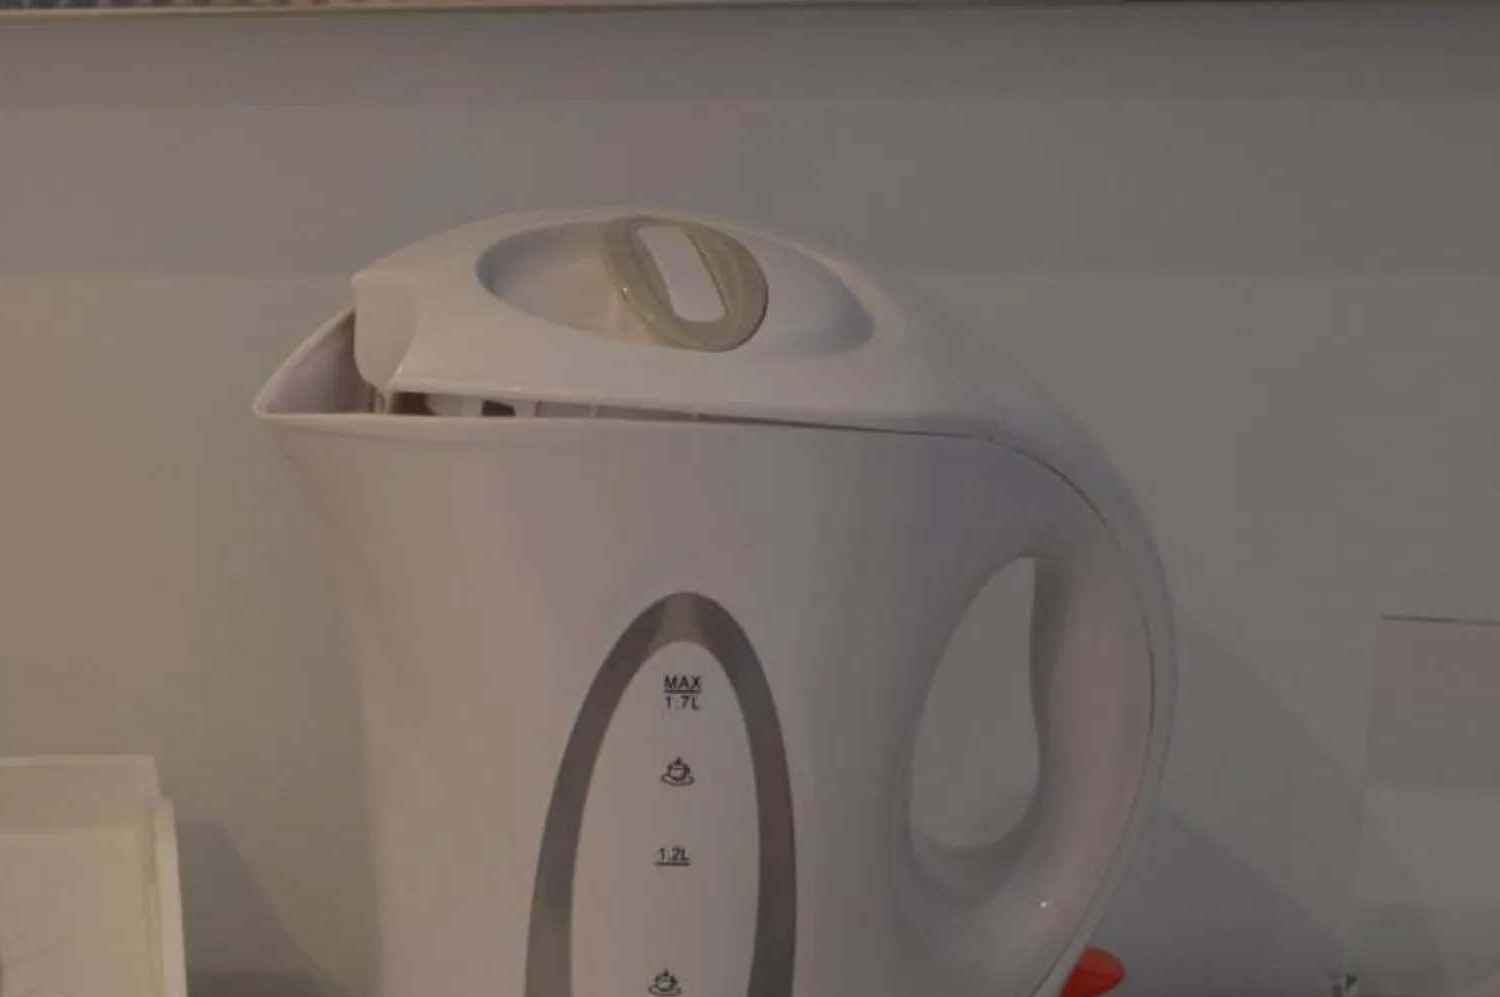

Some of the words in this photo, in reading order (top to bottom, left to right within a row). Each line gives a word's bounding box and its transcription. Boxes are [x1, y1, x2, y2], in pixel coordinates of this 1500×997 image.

[664, 674, 702, 690] MAX
[665, 694, 700, 711] 1.7L
[658, 847, 691, 861] 1.2L
